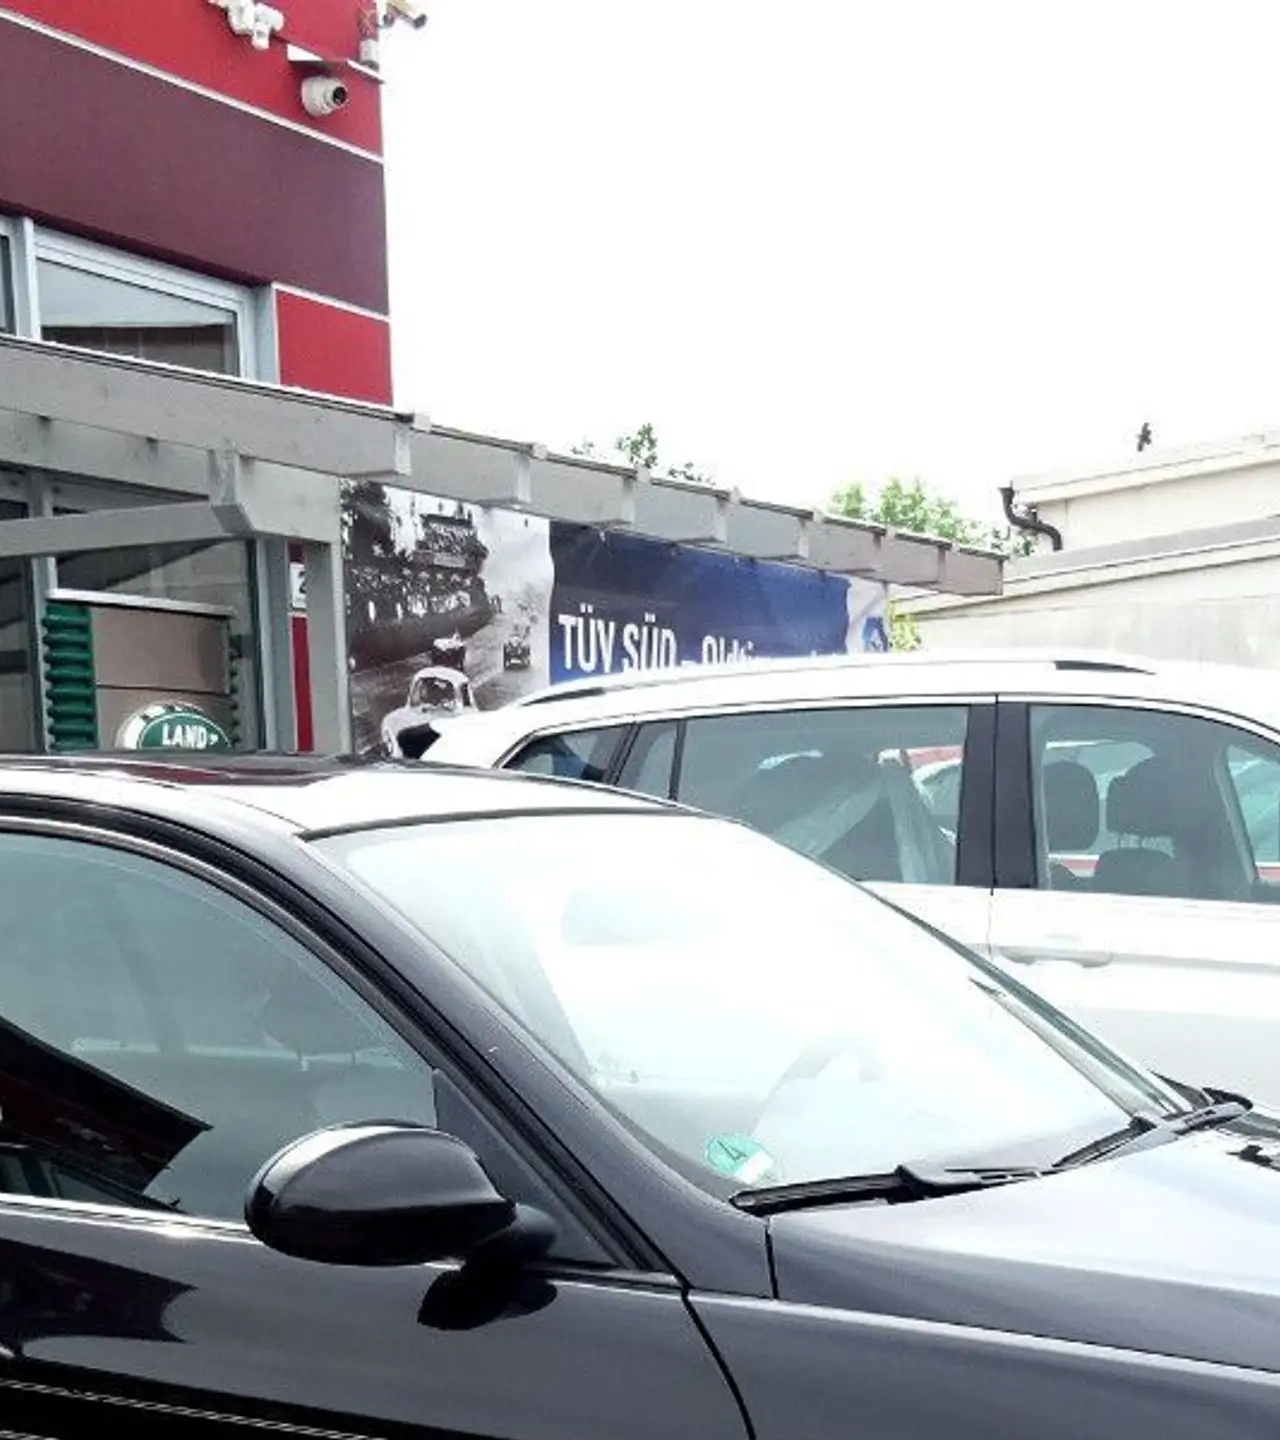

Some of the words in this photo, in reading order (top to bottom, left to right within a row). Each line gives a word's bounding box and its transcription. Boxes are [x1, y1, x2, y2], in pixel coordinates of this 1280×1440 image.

[558, 603, 616, 674] TÜV
[622, 612, 677, 674] SÜD
[162, 723, 207, 750] LAND
